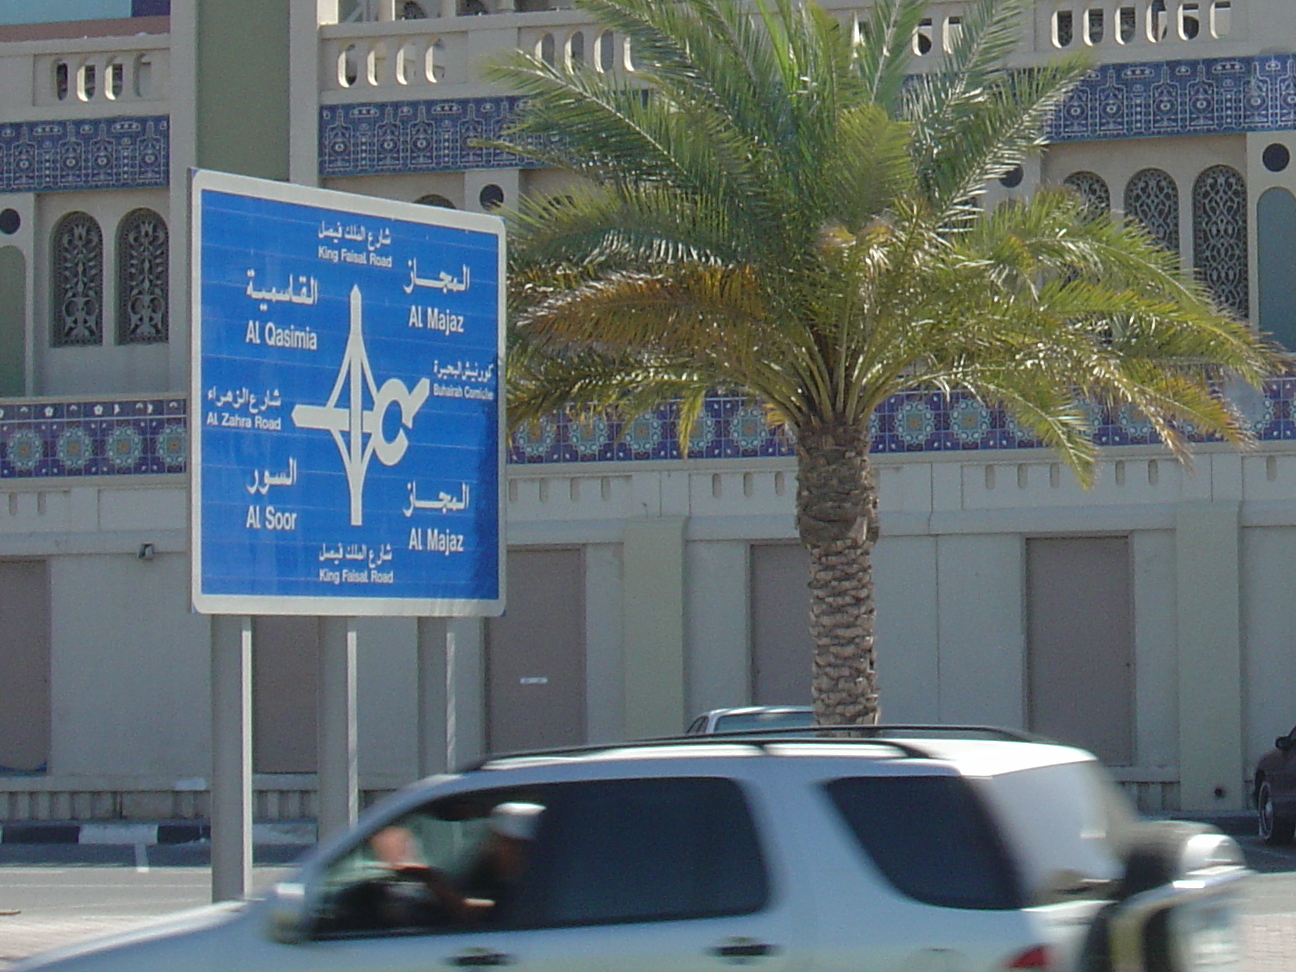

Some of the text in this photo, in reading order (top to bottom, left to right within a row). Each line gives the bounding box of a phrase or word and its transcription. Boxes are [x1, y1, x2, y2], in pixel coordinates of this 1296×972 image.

[318, 220, 391, 251] شارع الملك فيصل
[318, 245, 392, 268] King Faisal Road
[246, 268, 318, 312] القاسمية
[402, 257, 470, 294] المجاز
[245, 319, 318, 350] Al Qasimia
[408, 304, 464, 336] Al Majaz
[433, 359, 494, 383] كورنيش البحيرة
[207, 385, 282, 414] شارع الزهراء
[206, 411, 282, 430] Al Zahra Road
[245, 455, 297, 496] السور
[402, 479, 470, 518] المجاز
[245, 504, 297, 530] Al Soor
[319, 542, 393, 569] شارع الملك فيصل
[408, 527, 464, 556] Al Majaz
[319, 568, 394, 585] King Faisal Road
